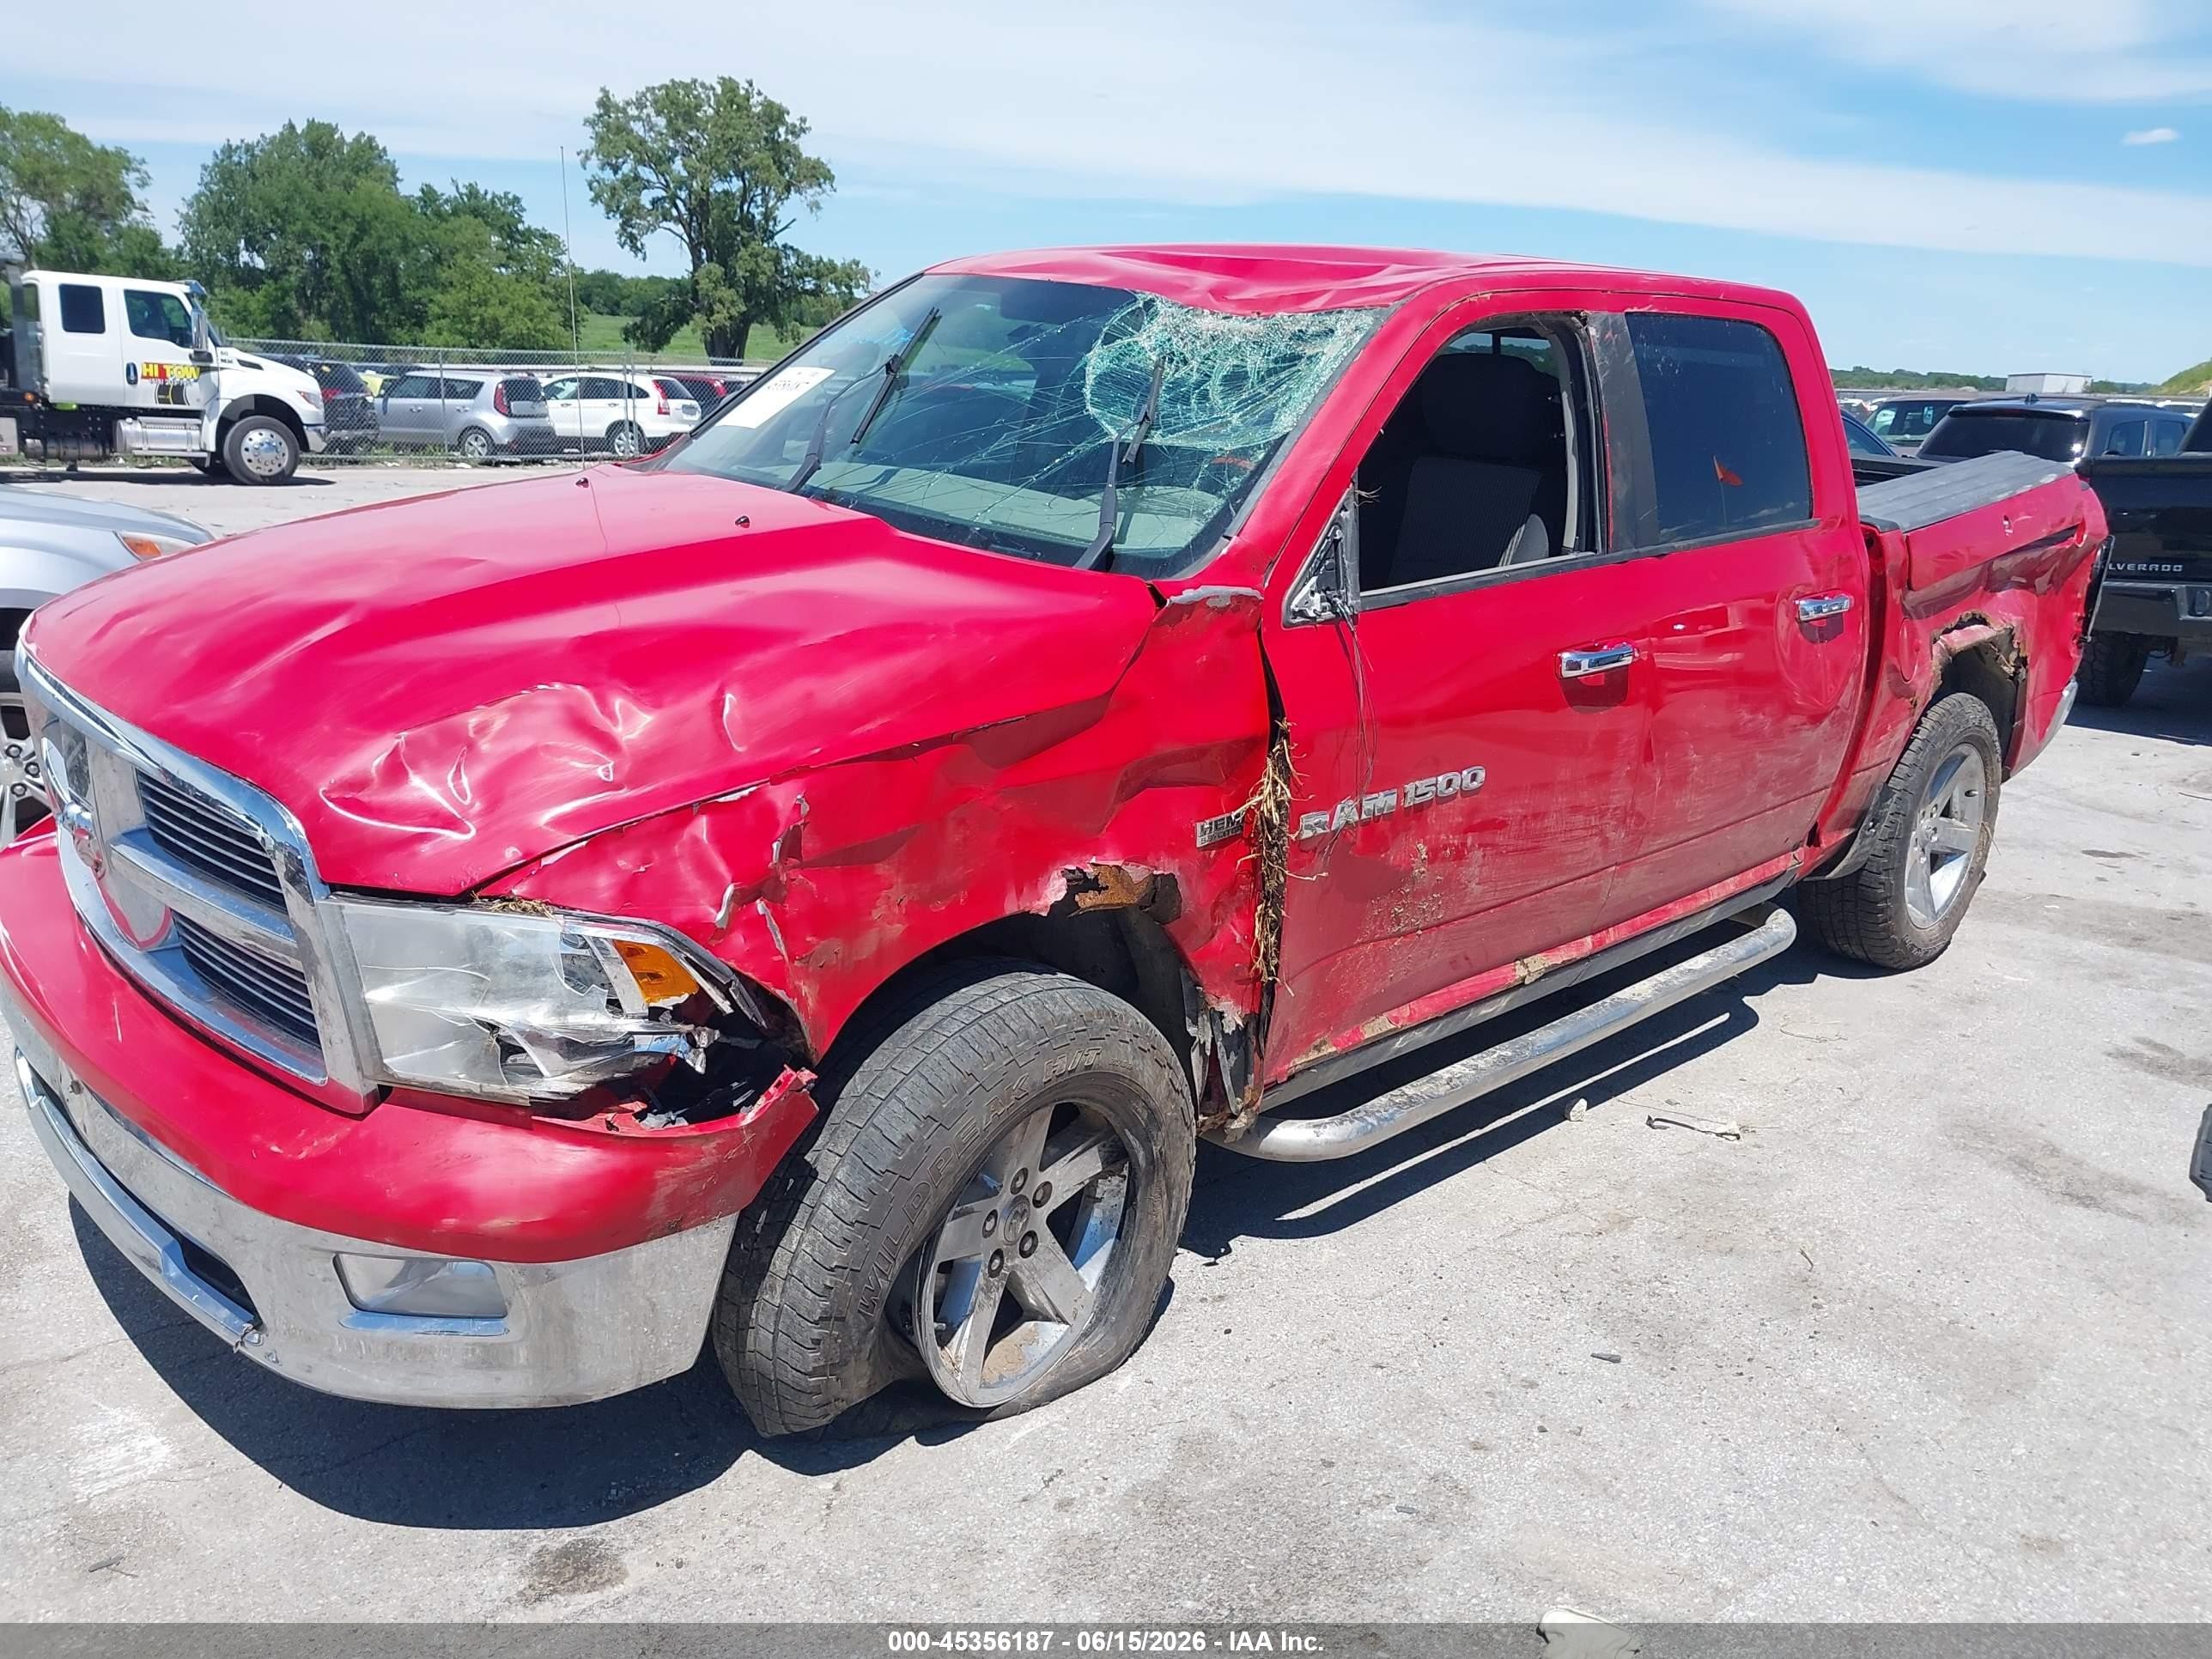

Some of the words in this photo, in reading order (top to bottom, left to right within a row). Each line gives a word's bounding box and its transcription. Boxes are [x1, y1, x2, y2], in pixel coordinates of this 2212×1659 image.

[143, 363, 158, 378] HI
[163, 364, 200, 380] TOW
[2108, 562, 2184, 572] LVERADO
[1299, 788, 1398, 840] RAM
[1402, 765, 1486, 807] 1500
[857, 1073, 1030, 1320] WILDPEAK
[1043, 1045, 1103, 1084] H/T
